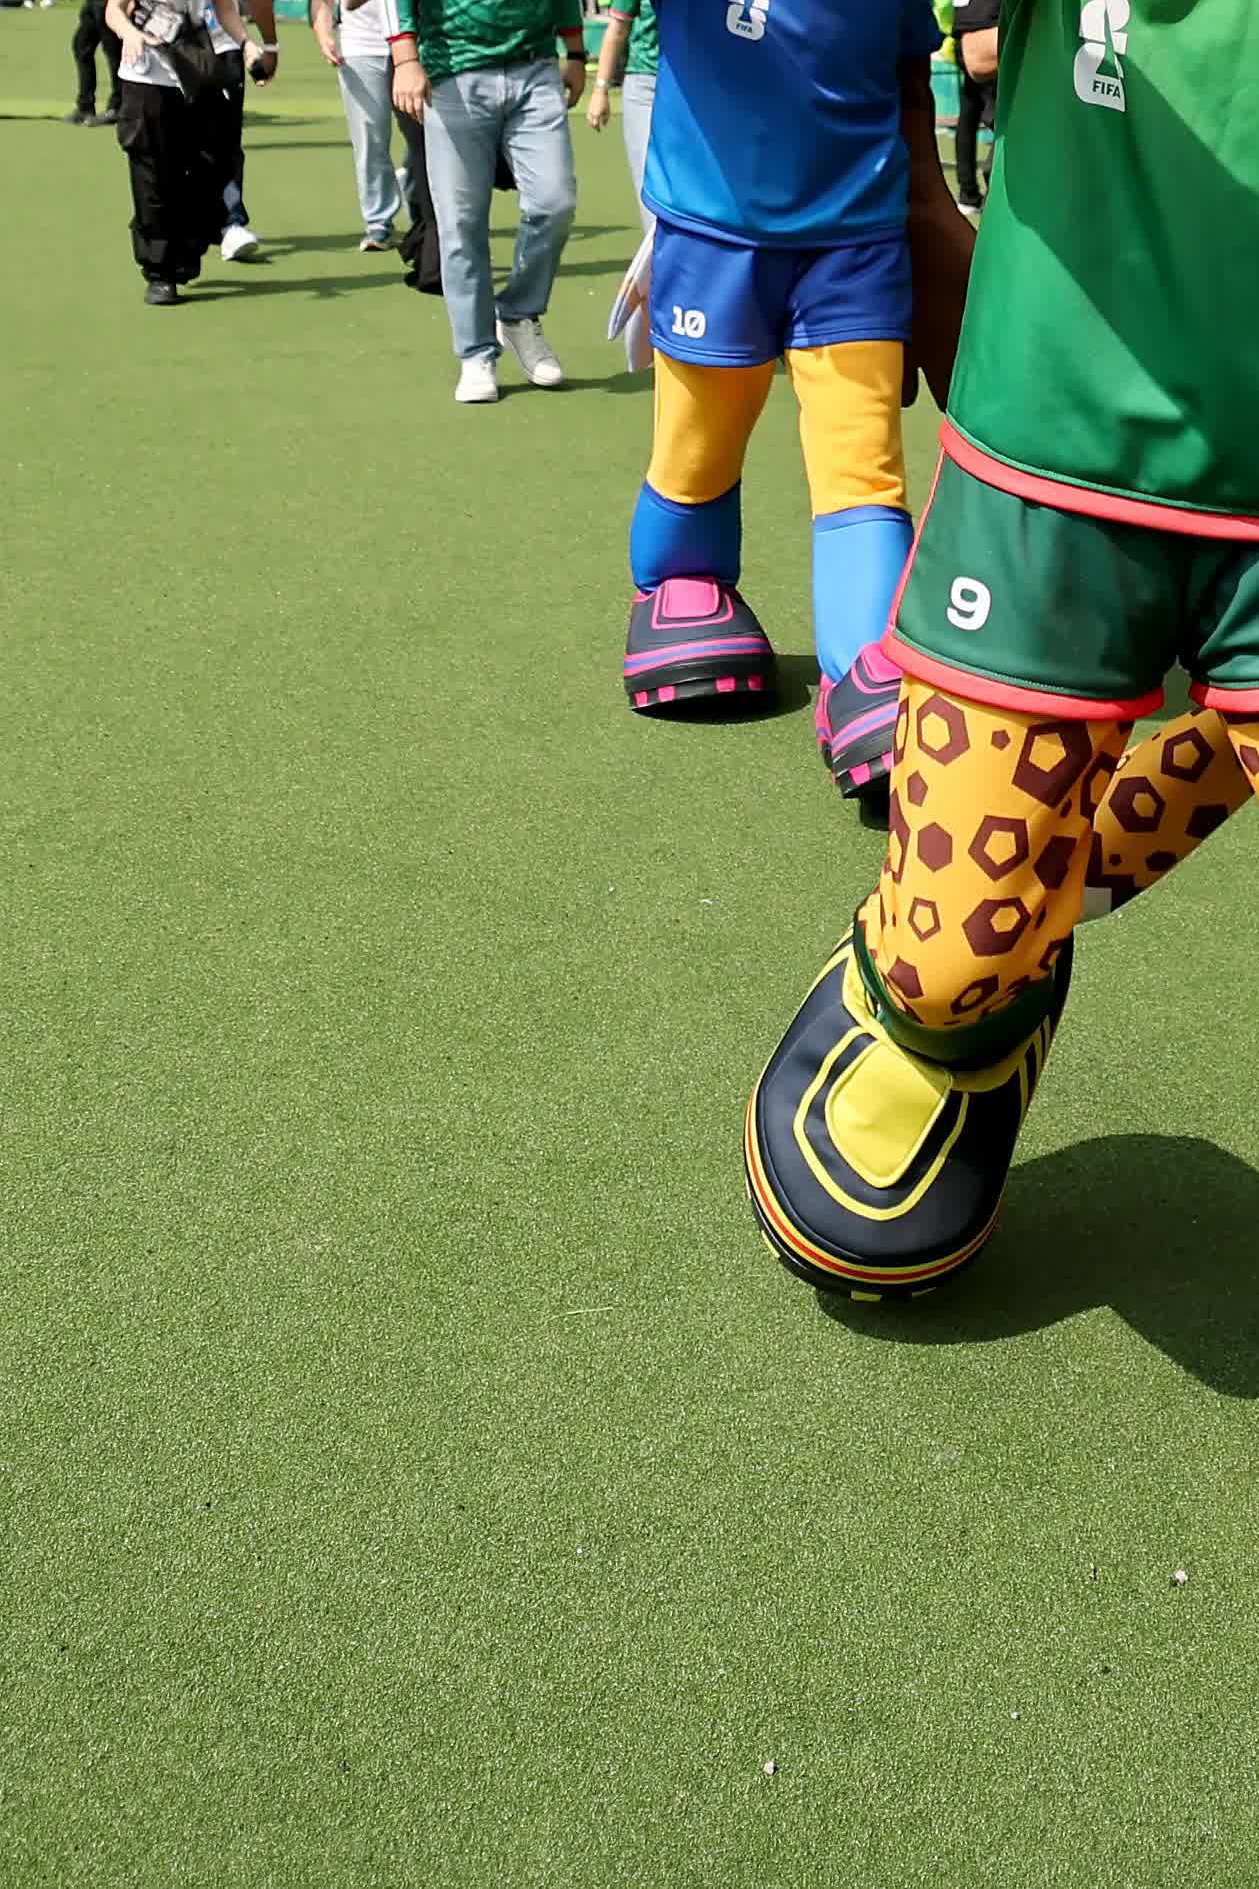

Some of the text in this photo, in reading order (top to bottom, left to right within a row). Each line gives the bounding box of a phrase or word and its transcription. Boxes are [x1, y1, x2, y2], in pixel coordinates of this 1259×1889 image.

[1092, 79, 1121, 99] FIFA
[671, 304, 706, 339] 10
[946, 575, 991, 631] 9
